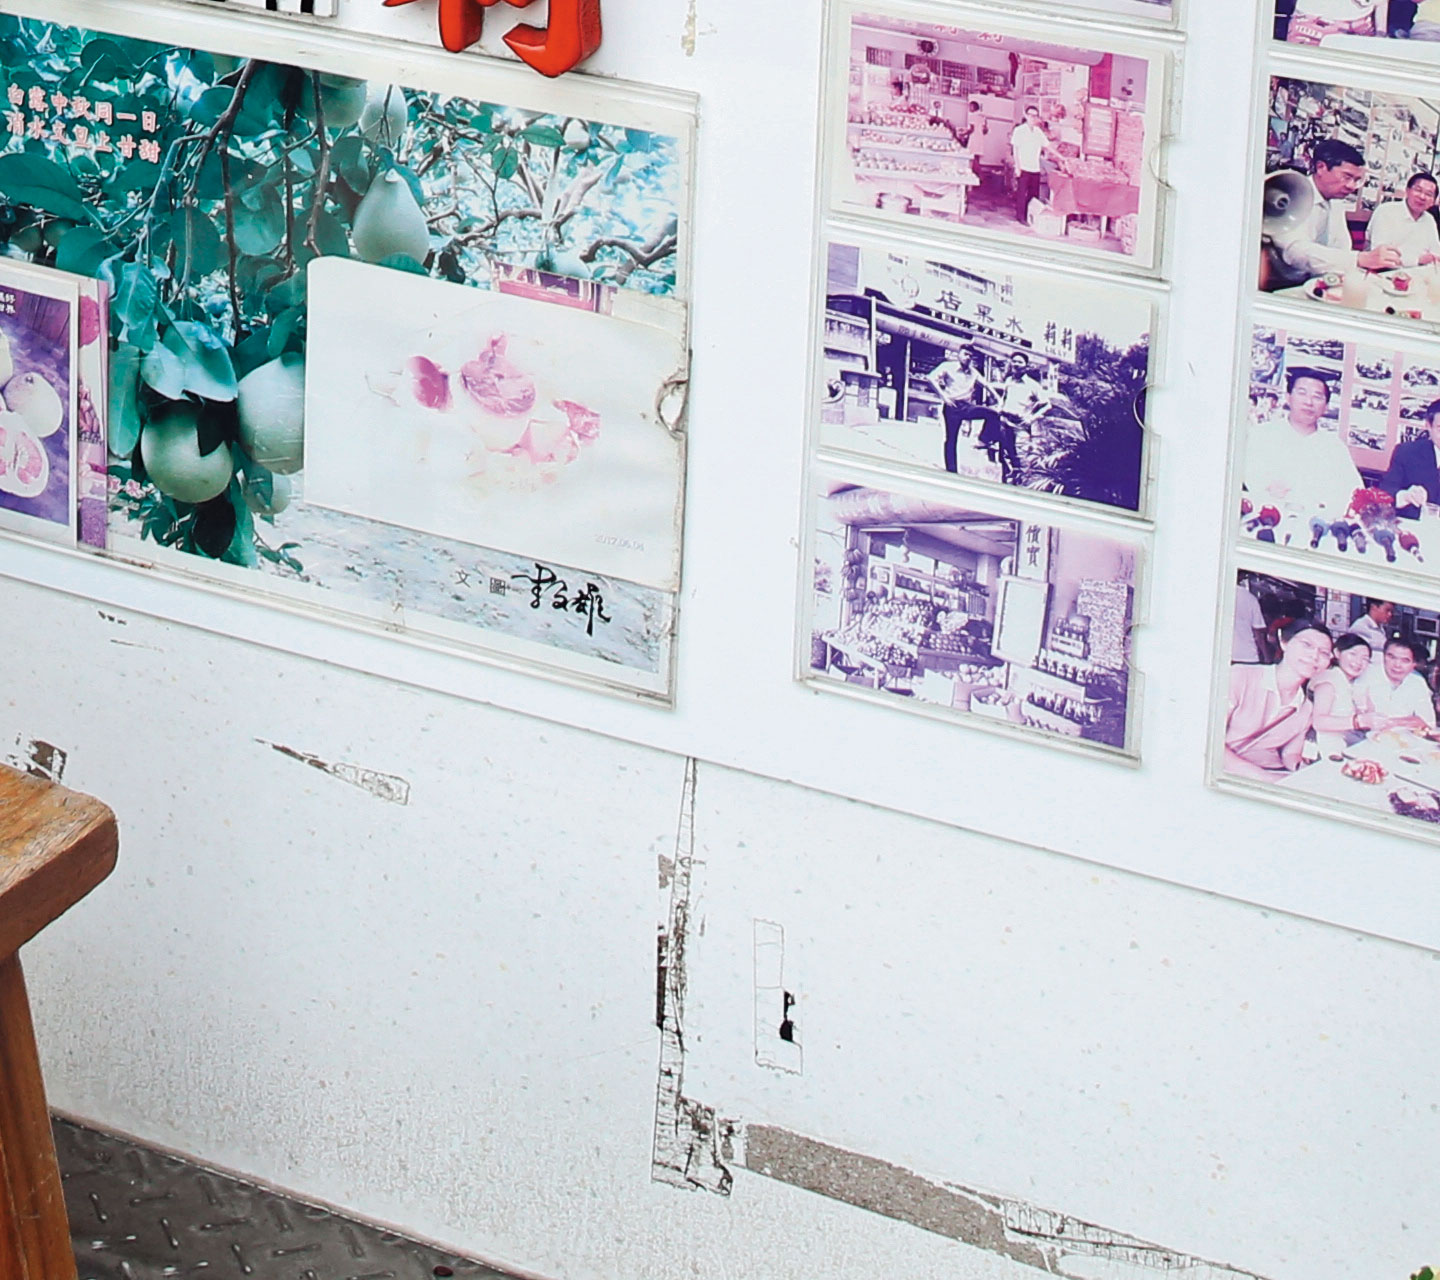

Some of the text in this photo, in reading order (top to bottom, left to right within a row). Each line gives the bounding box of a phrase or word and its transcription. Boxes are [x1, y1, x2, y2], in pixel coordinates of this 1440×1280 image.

[7, 83, 160, 133] 白露中秋同一日
